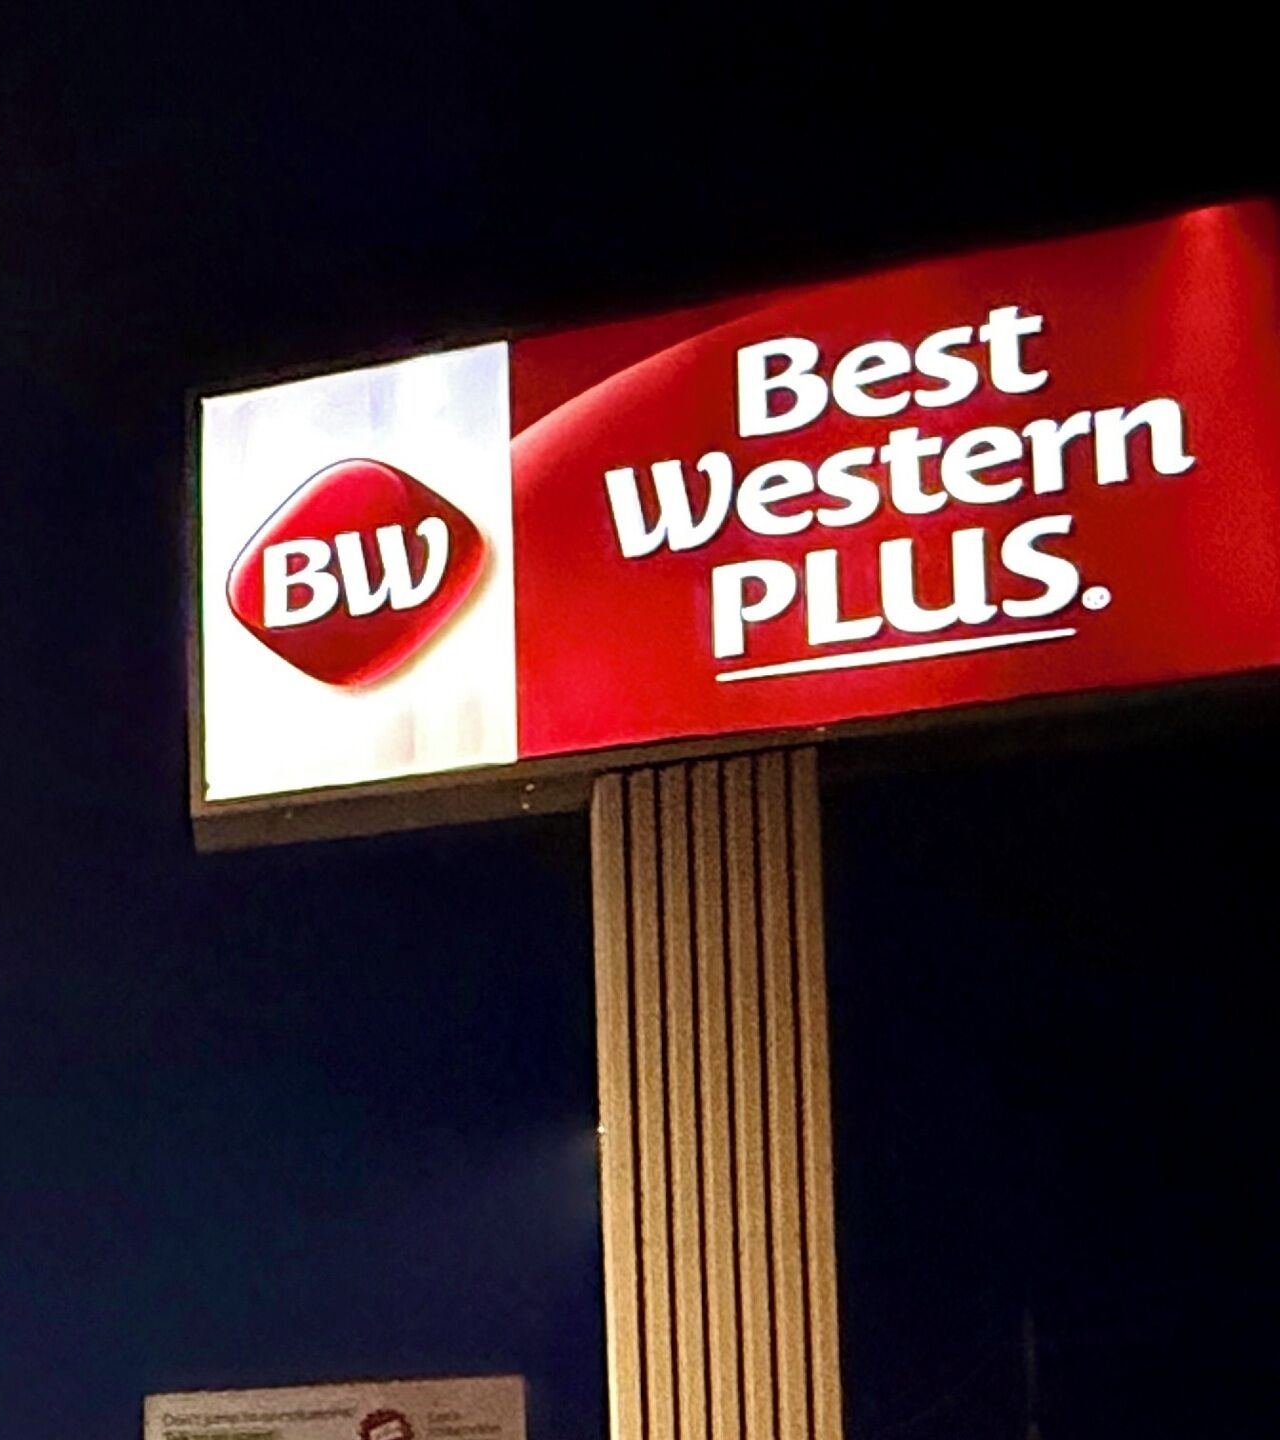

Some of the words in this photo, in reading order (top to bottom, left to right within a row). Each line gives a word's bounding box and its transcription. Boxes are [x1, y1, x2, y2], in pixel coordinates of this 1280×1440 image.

[737, 305, 1048, 438] Best
[604, 398, 1195, 558] Western
[263, 516, 449, 628] BW
